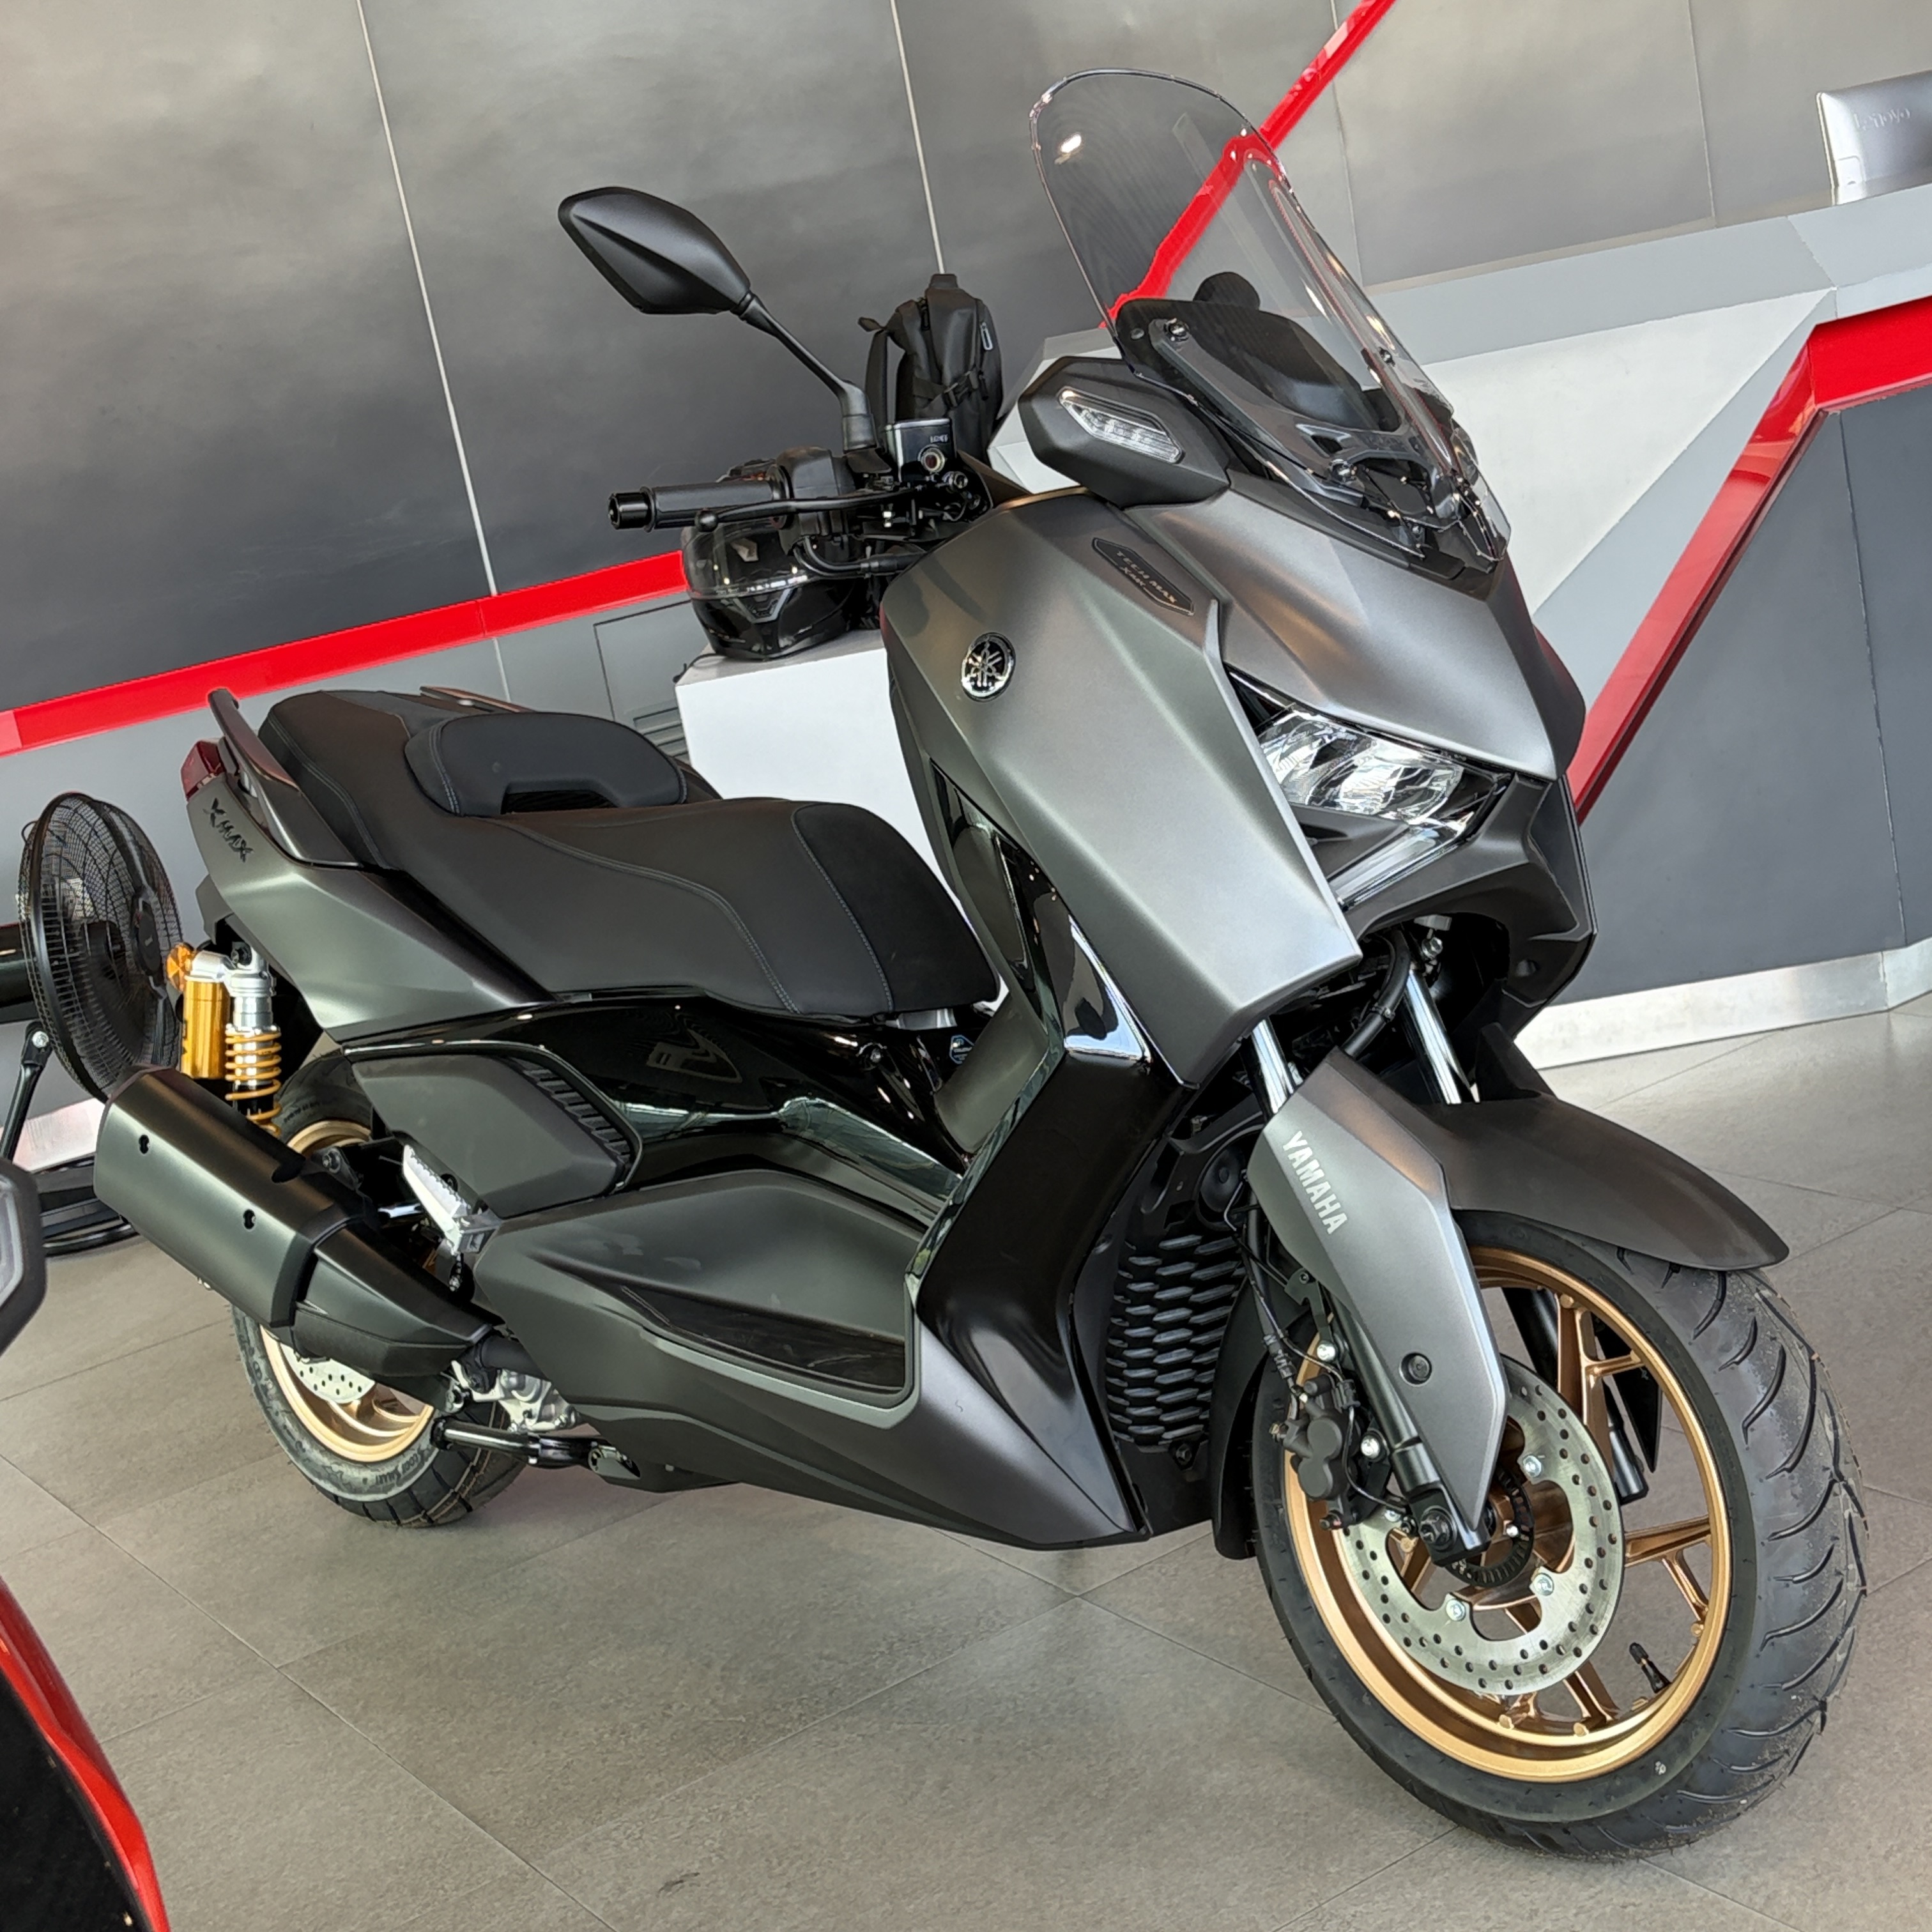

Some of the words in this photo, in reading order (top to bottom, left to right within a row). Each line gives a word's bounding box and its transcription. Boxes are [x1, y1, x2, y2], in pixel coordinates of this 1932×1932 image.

[1853, 107, 1910, 130] Lenovo
[1117, 551, 1149, 579] TECH
[203, 797, 254, 862] XMAX
[1283, 1130, 1348, 1234] YAMAHA
